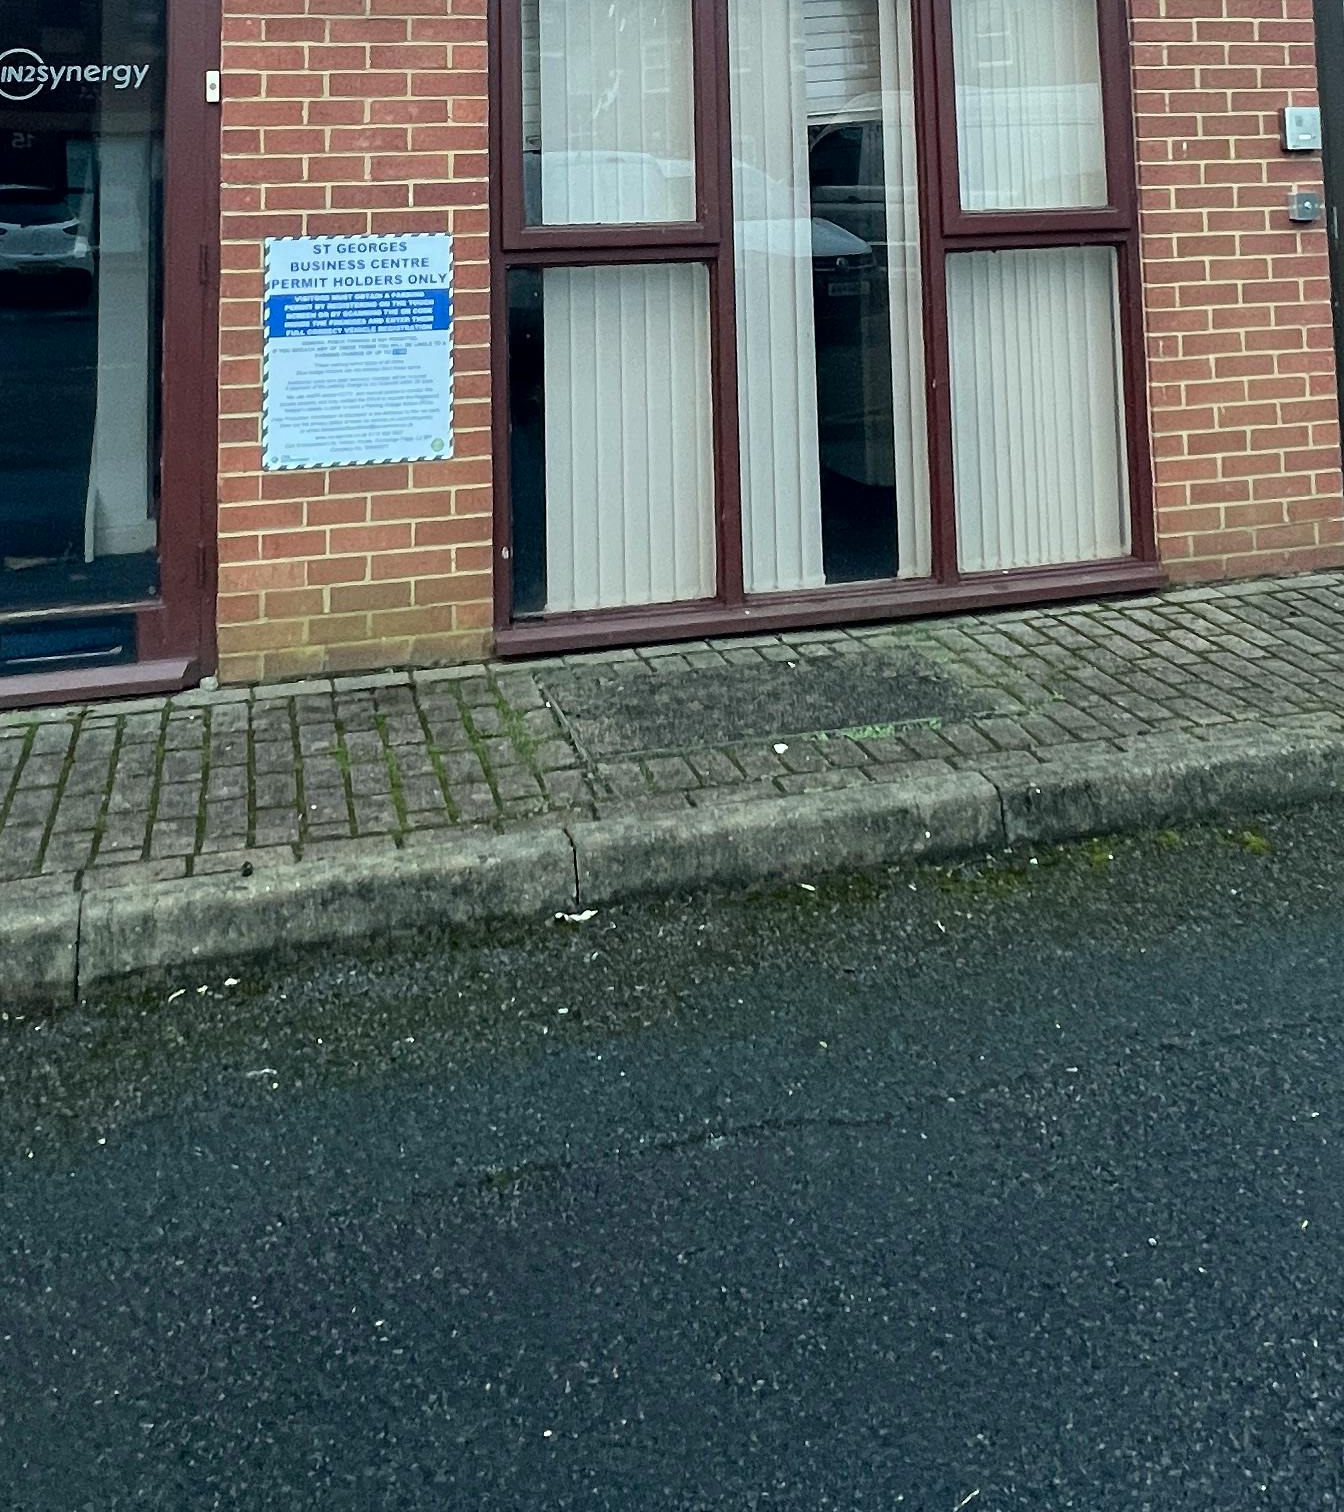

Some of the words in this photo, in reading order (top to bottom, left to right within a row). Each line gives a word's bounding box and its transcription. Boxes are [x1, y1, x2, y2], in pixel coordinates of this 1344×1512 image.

[313, 244, 332, 255] ST
[337, 242, 407, 254] GEORGES
[290, 260, 365, 272] BUSINESS
[371, 257, 430, 269] CENTRE
[271, 277, 328, 289] PERMIT
[333, 275, 402, 288] HOLDERS
[408, 273, 447, 285] ONLY
